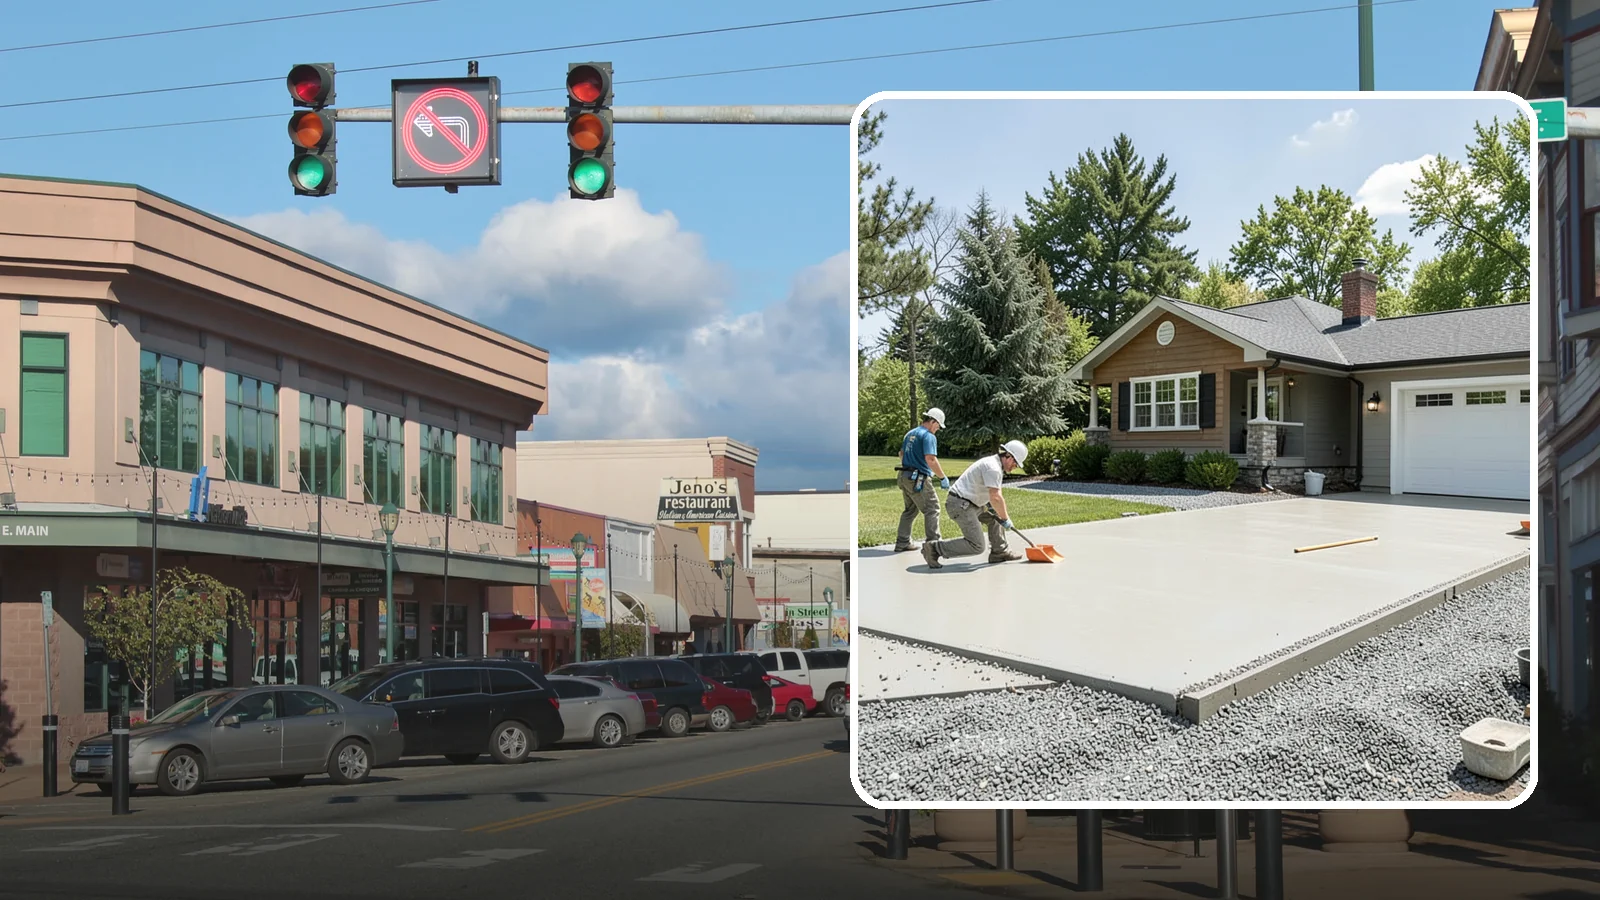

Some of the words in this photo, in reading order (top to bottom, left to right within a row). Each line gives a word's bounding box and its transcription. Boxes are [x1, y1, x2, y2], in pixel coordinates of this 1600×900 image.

[669, 479, 728, 495] Jeno's
[664, 496, 731, 509] restaurant
[658, 509, 681, 519] Italian
[685, 509, 714, 519] American
[714, 509, 738, 519] Cuisine
[2, 525, 13, 536] E.
[15, 525, 49, 536] MAIN
[797, 607, 828, 617] Street
